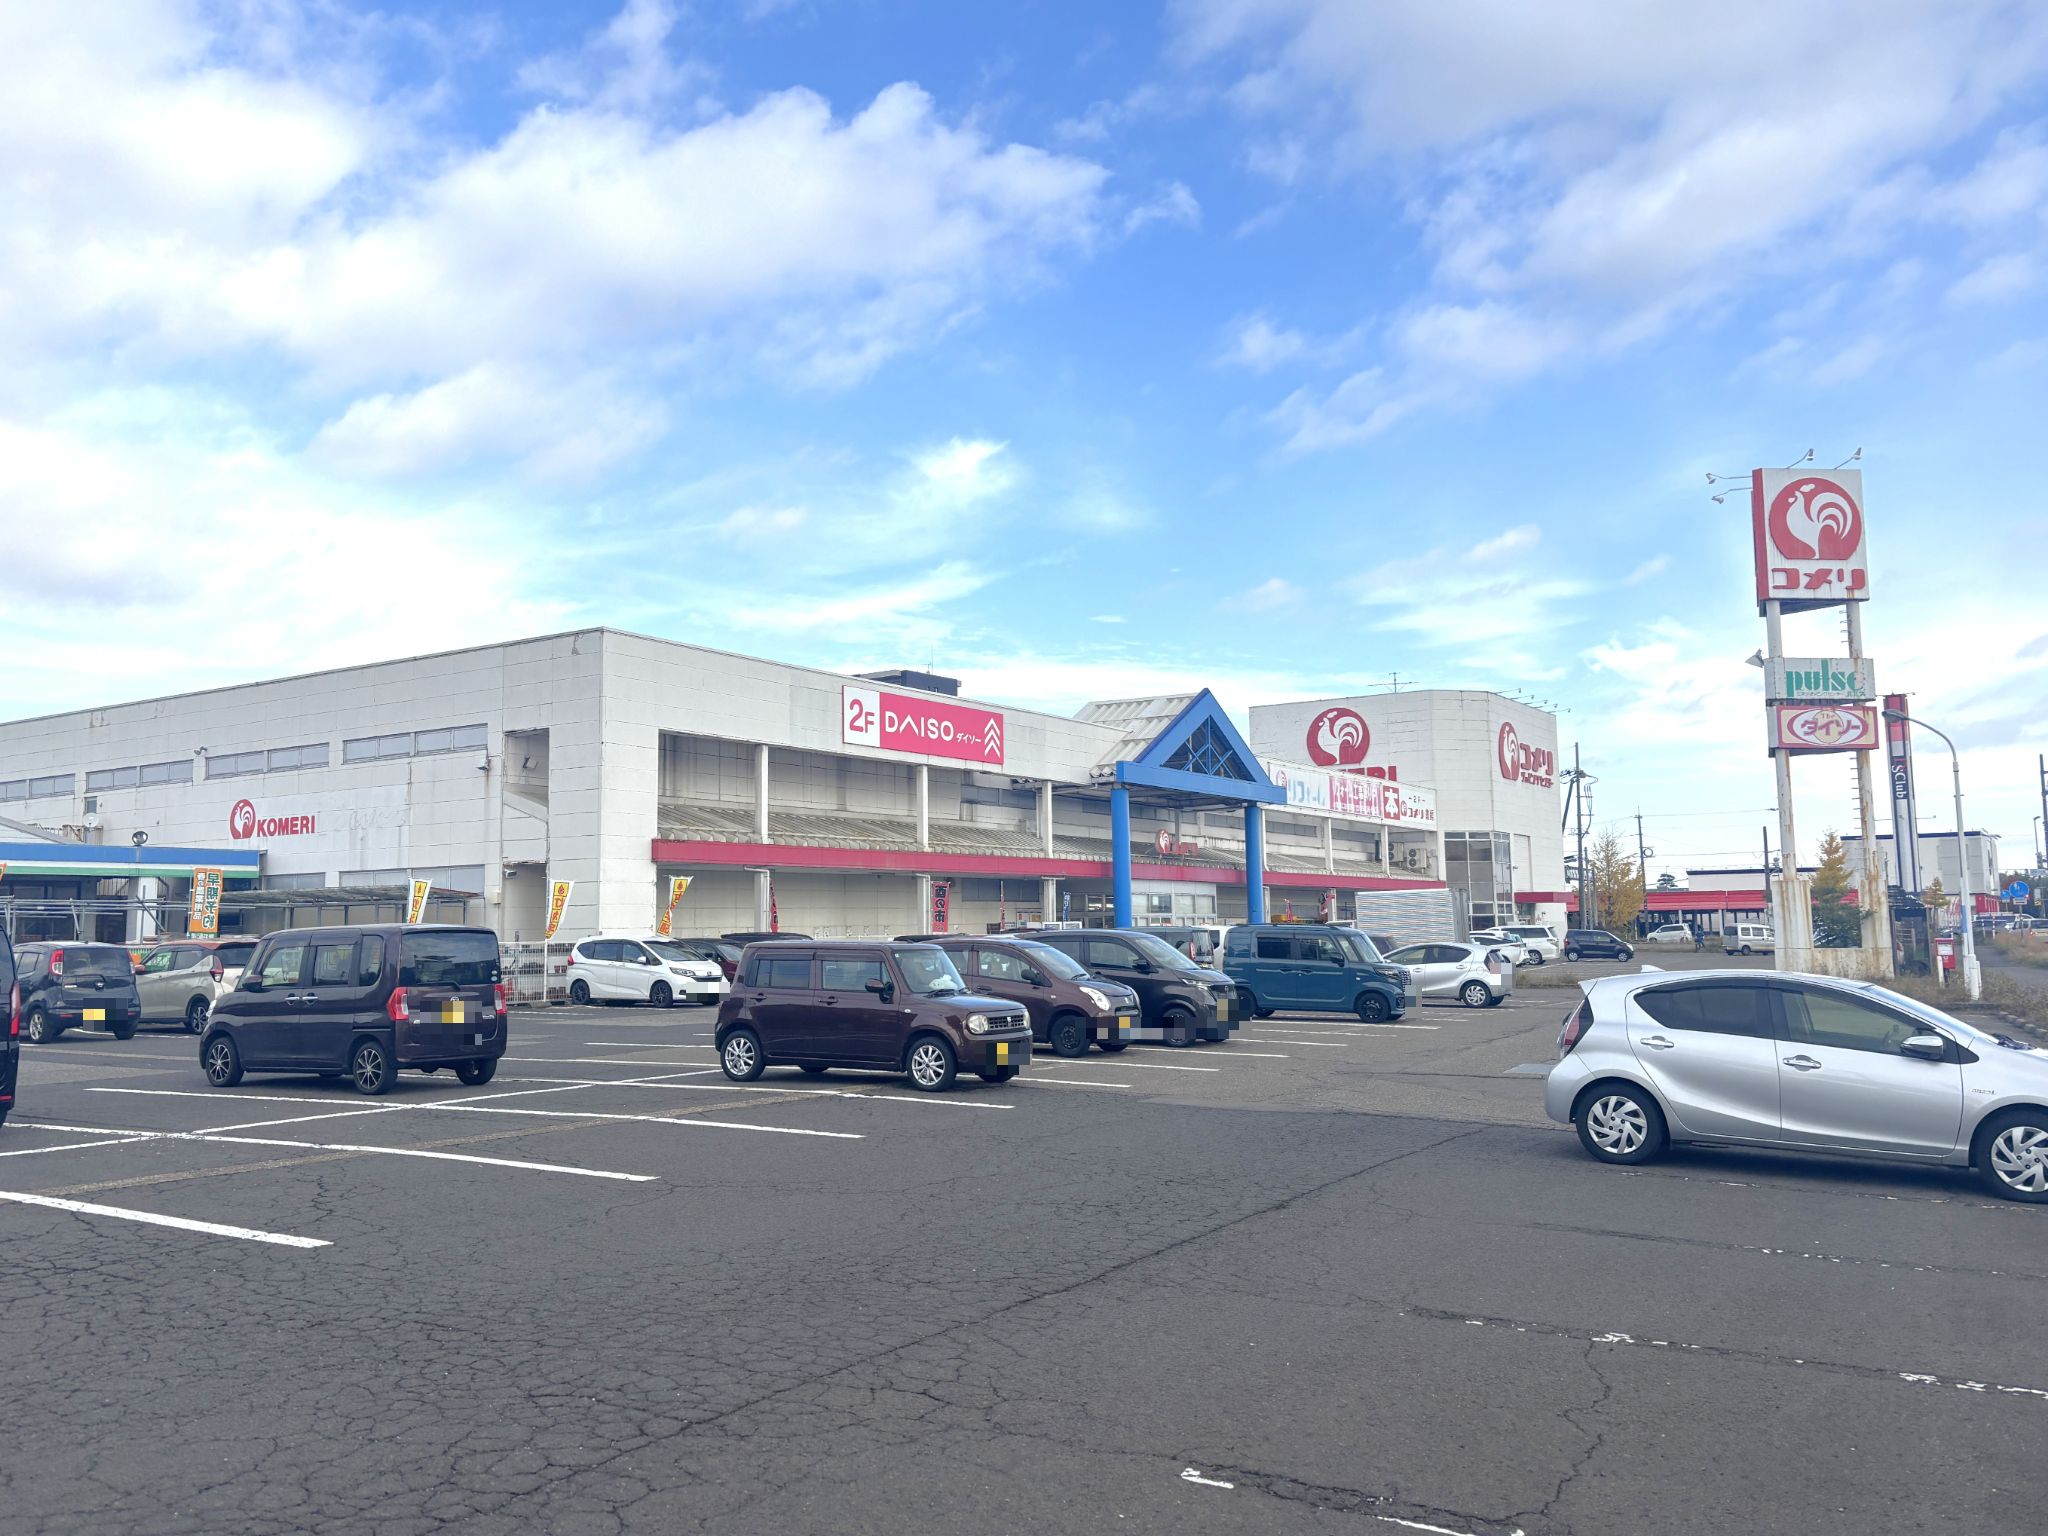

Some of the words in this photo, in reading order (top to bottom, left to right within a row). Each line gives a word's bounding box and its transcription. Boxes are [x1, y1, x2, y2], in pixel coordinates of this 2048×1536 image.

[1771, 567, 1866, 591] コメリ
[1786, 658, 1865, 697] pulse
[849, 698, 875, 734] 2F
[885, 710, 954, 742] DAISO
[956, 732, 982, 745] ダイソー
[1520, 742, 1554, 776] コメリ
[1385, 788, 1398, 818] 本
[257, 815, 316, 838] KOMERI
